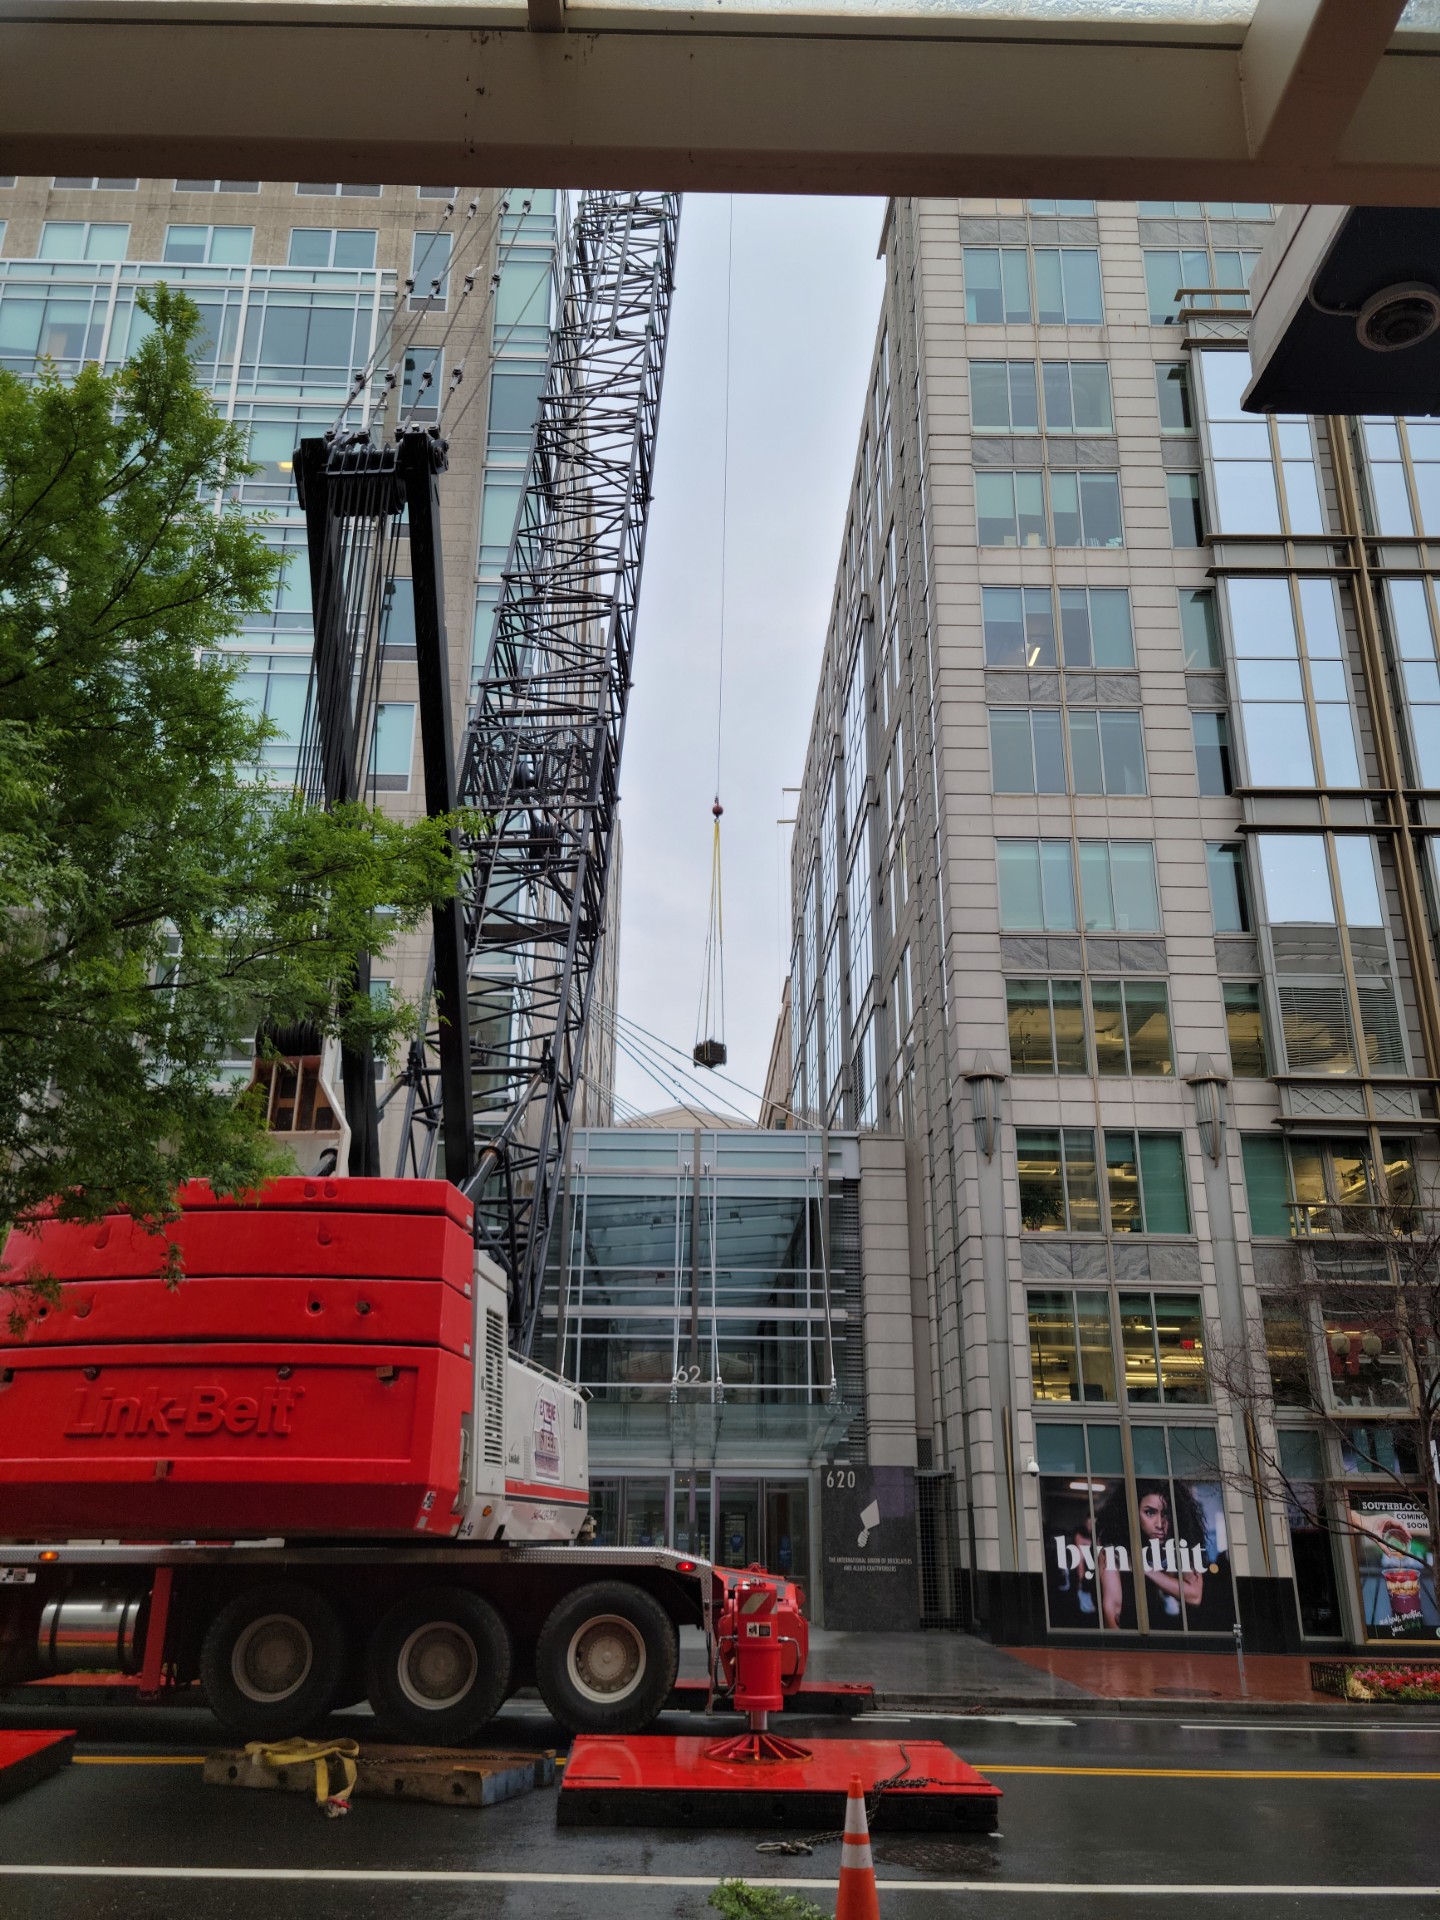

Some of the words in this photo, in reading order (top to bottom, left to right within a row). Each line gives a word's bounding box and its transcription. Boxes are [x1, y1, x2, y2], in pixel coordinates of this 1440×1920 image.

[63, 1385, 295, 1438] Link-Belt
[826, 1470, 856, 1488] 620
[1361, 1501, 1427, 1511] SOUTHBLOC
